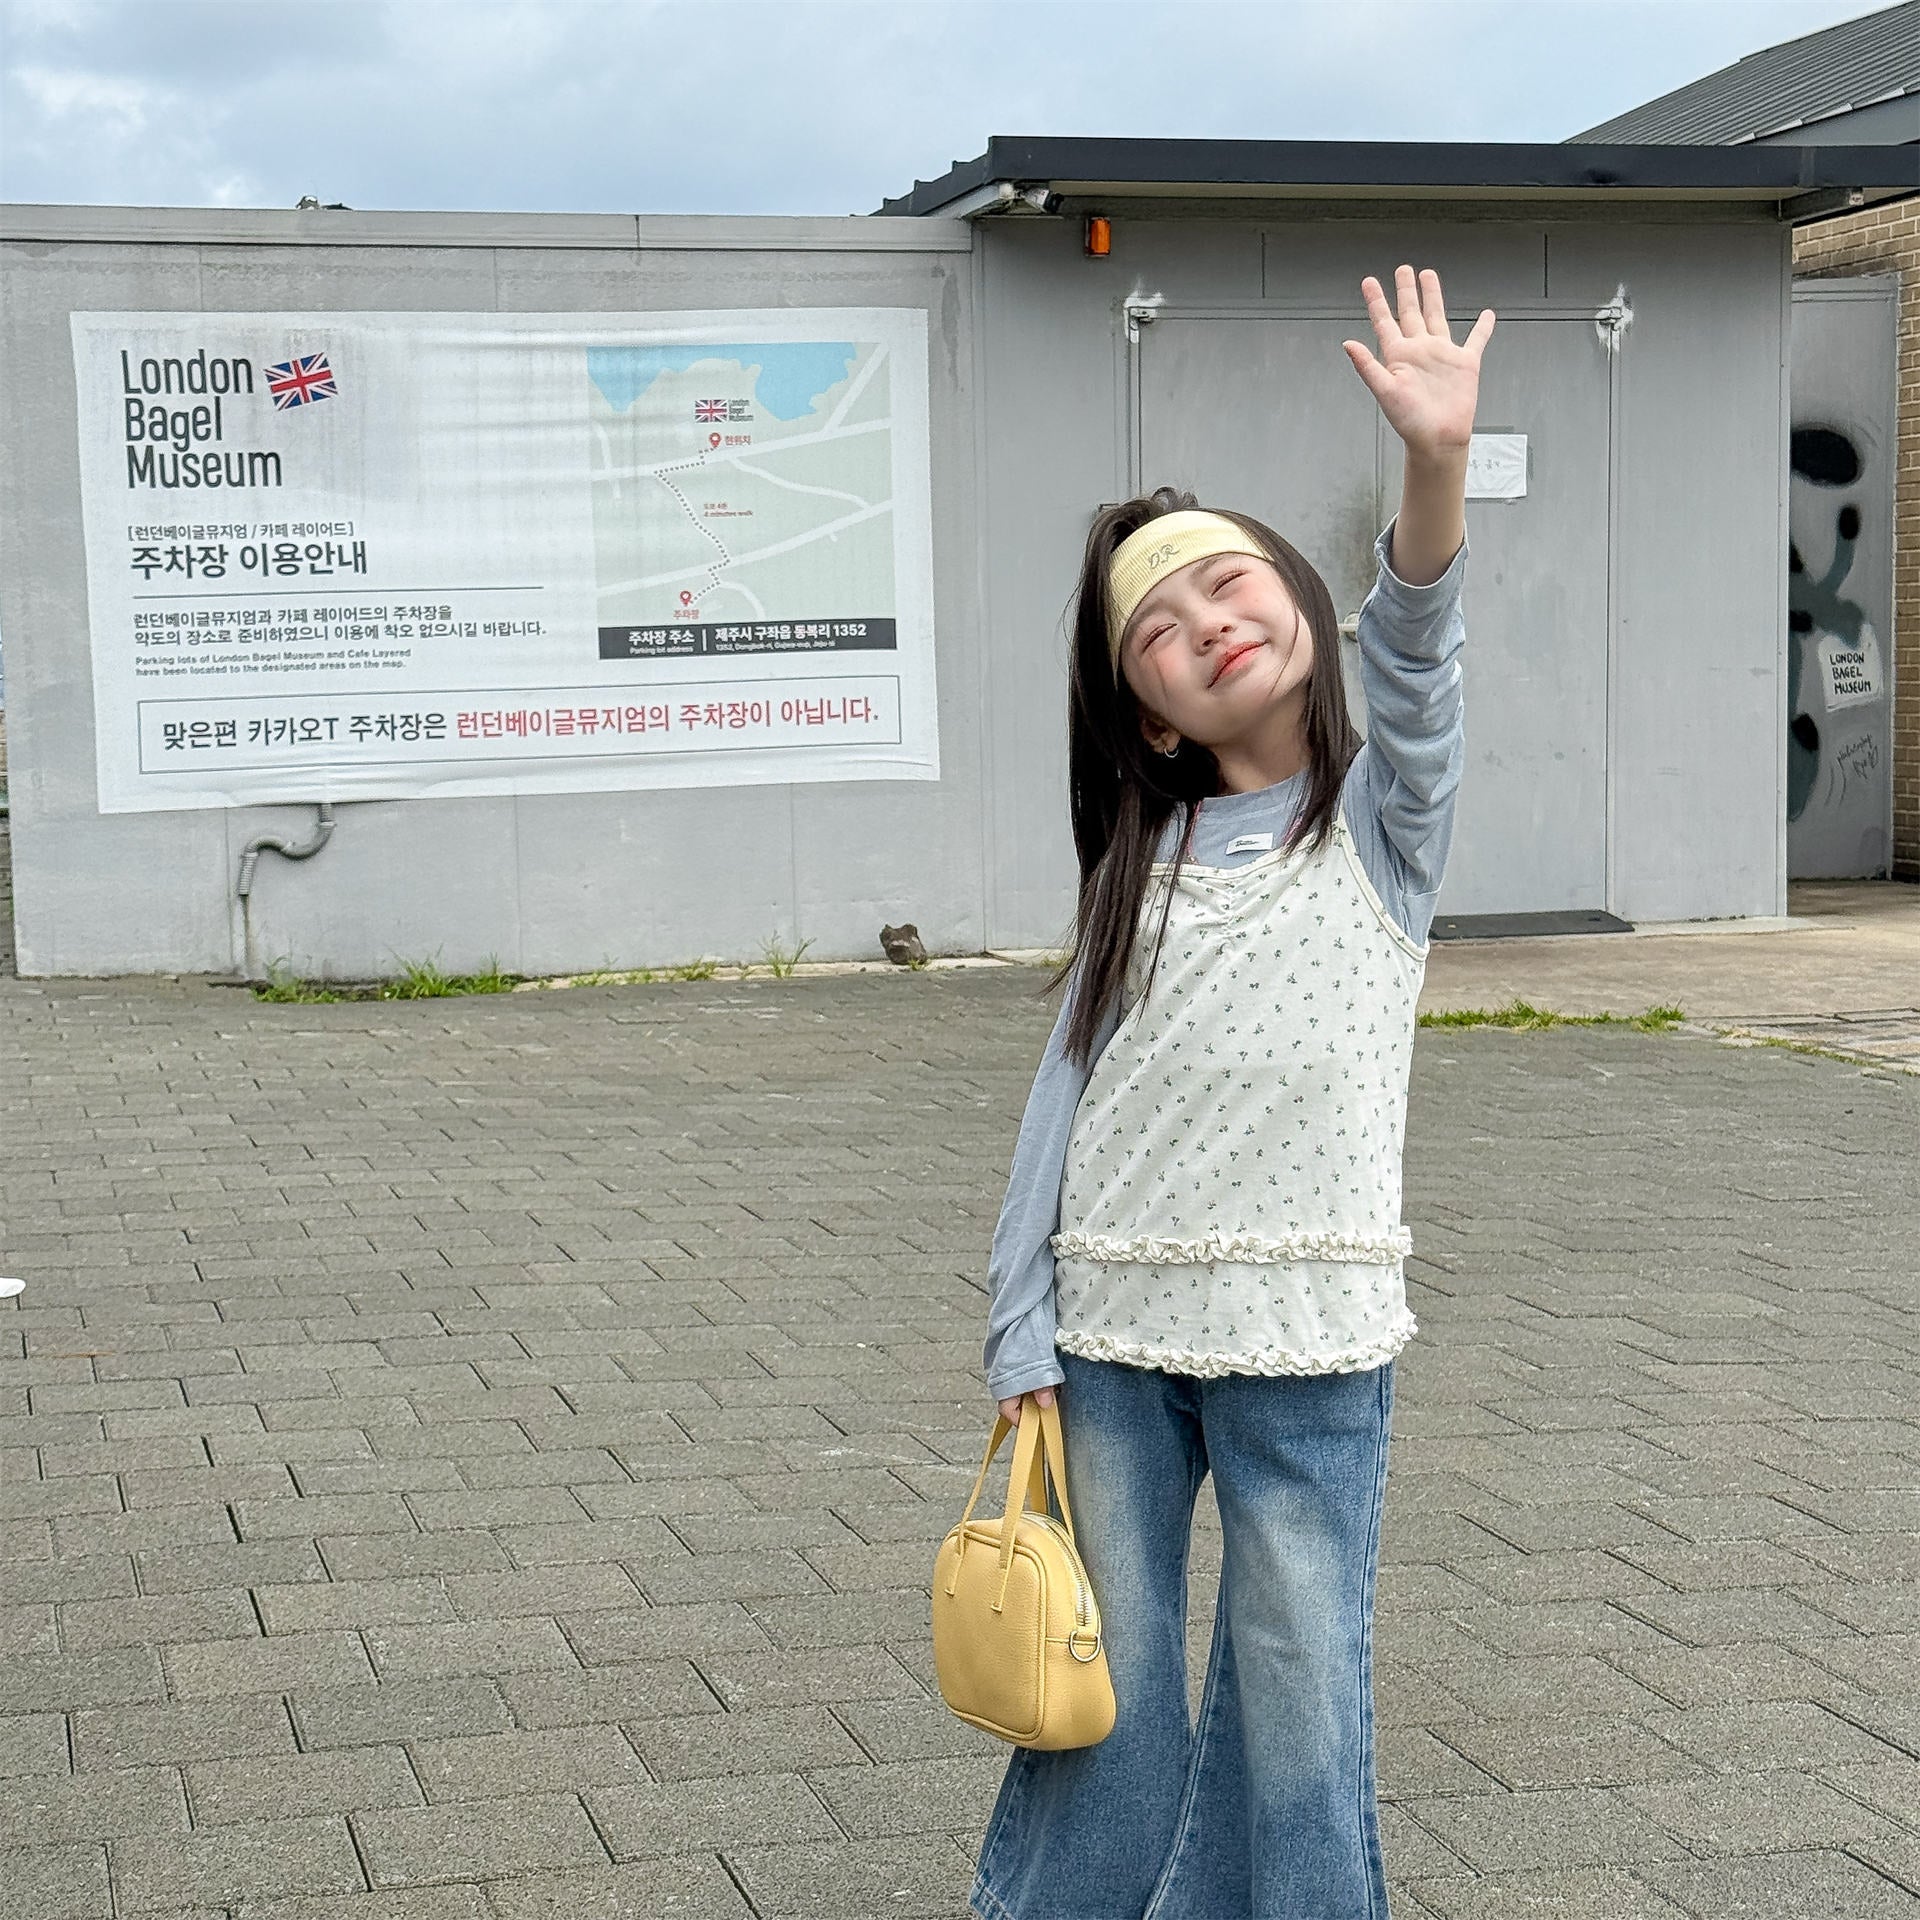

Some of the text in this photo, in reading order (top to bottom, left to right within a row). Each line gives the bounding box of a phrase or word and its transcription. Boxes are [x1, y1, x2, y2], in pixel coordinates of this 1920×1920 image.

[121, 349, 254, 395] London
[125, 395, 223, 452] Bagel
[127, 444, 283, 489] Museum
[128, 524, 248, 541] [런던베이글뮤지엄
[260, 522, 289, 538] 카페
[292, 521, 354, 538] 레이어드]
[130, 540, 368, 580] 주차장 이용안내
[134, 605, 453, 629] 런던베이글뮤지엄과 카페 레이어드의 주차장을
[135, 620, 547, 647] 약도의 장소로 준비하였으니 이용에 착오 없으시길 바랍니다.
[628, 623, 868, 646] 주차장 주소 제주시 구좌읍 동복리 1352
[135, 657, 175, 667] Parking
[199, 655, 210, 663] of
[212, 653, 250, 663] London
[252, 652, 282, 663] Bagel
[283, 651, 325, 661] Museum
[326, 650, 345, 659] and
[372, 649, 412, 659] Layered
[229, 665, 241, 673] to
[261, 662, 317, 672] designated
[348, 661, 362, 669] on
[1829, 651, 1865, 665] LONDON
[1832, 666, 1863, 680] BAGEL
[1834, 680, 1871, 694] MUSEUM
[163, 695, 880, 751] 맞은편 카카오T 주차장은 런던베이글뮤지엄의 주차장이 아닙니다.
